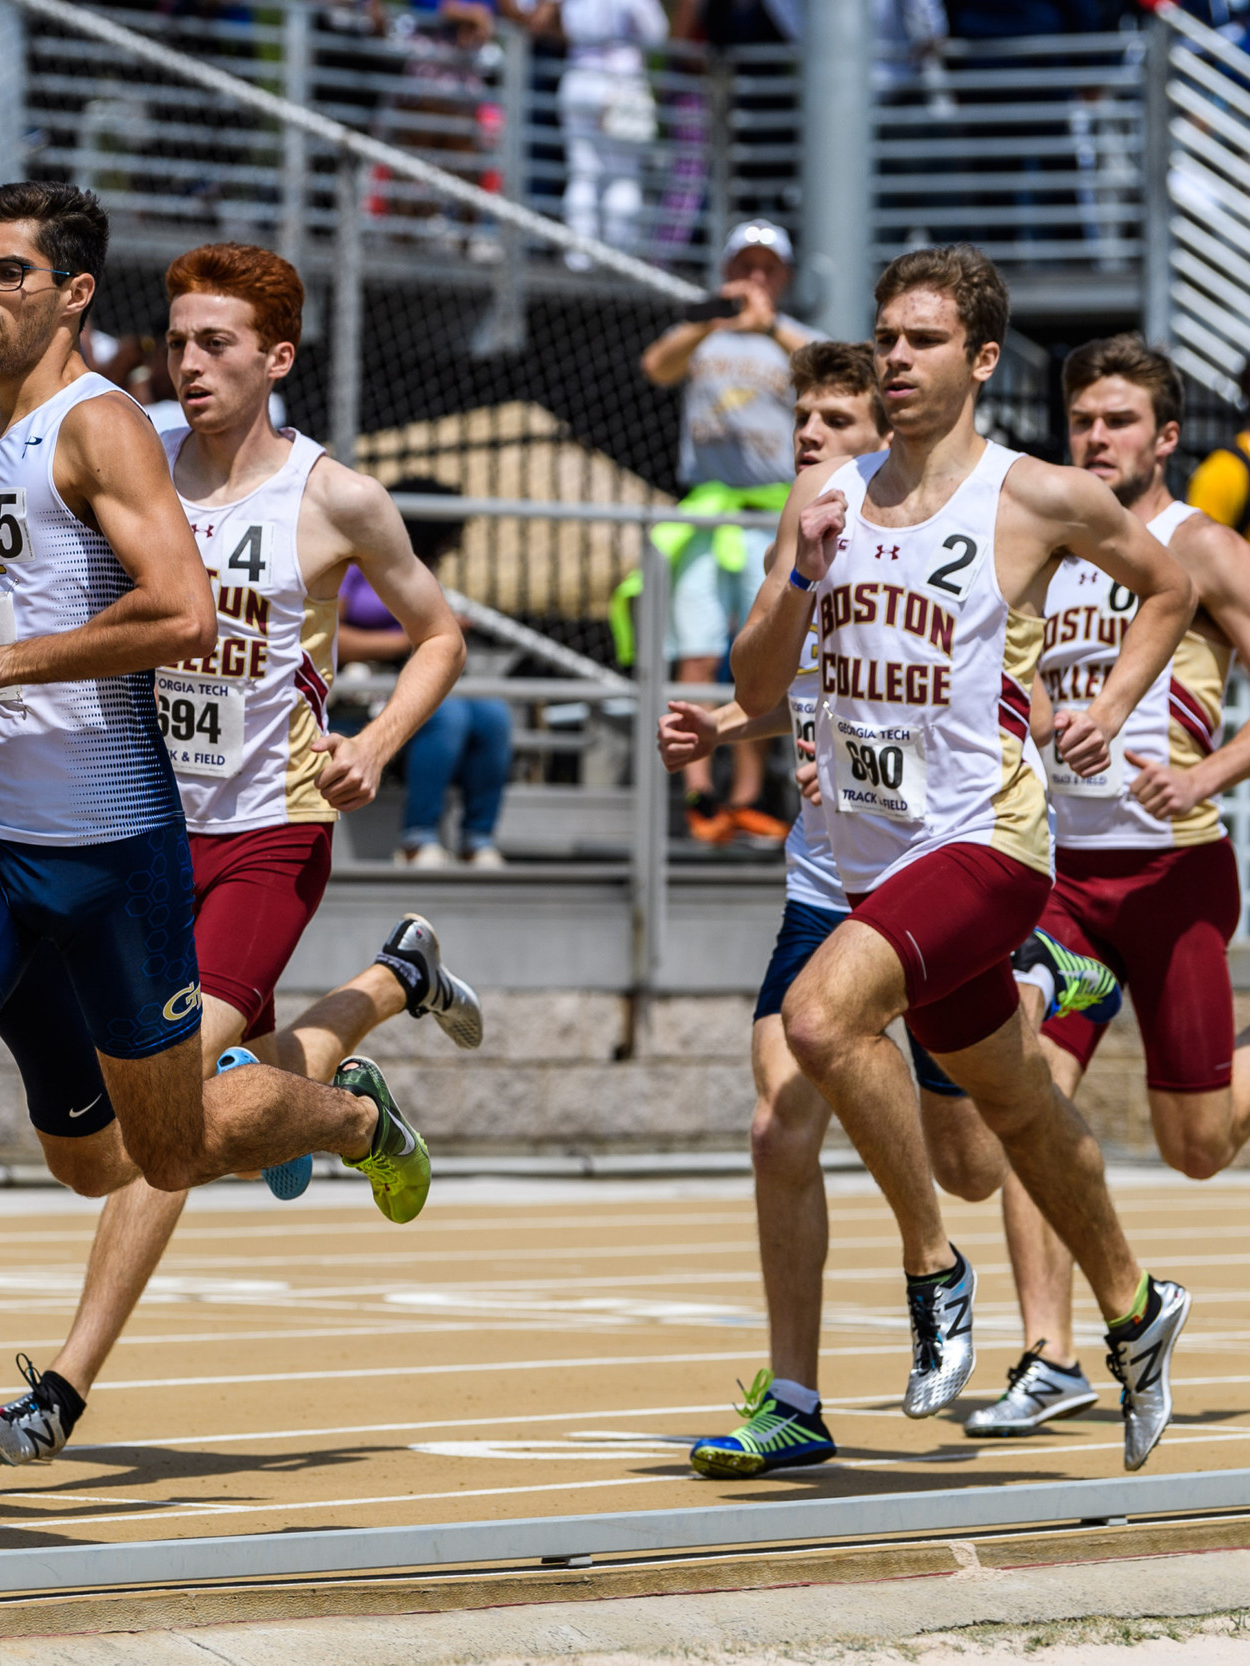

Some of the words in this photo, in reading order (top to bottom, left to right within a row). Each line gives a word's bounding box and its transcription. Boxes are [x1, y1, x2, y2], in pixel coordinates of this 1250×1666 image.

[228, 525, 267, 583] 4
[926, 532, 978, 596] 2
[820, 582, 957, 661] BOSTON
[157, 678, 195, 694] ORGIA
[198, 683, 229, 697] TECH
[821, 651, 952, 707] COLLEGE
[158, 694, 222, 744] 694
[879, 729, 911, 741] TECH
[181, 751, 190, 762] &
[194, 752, 226, 766] FIELD
[842, 788, 877, 804] TRACK
